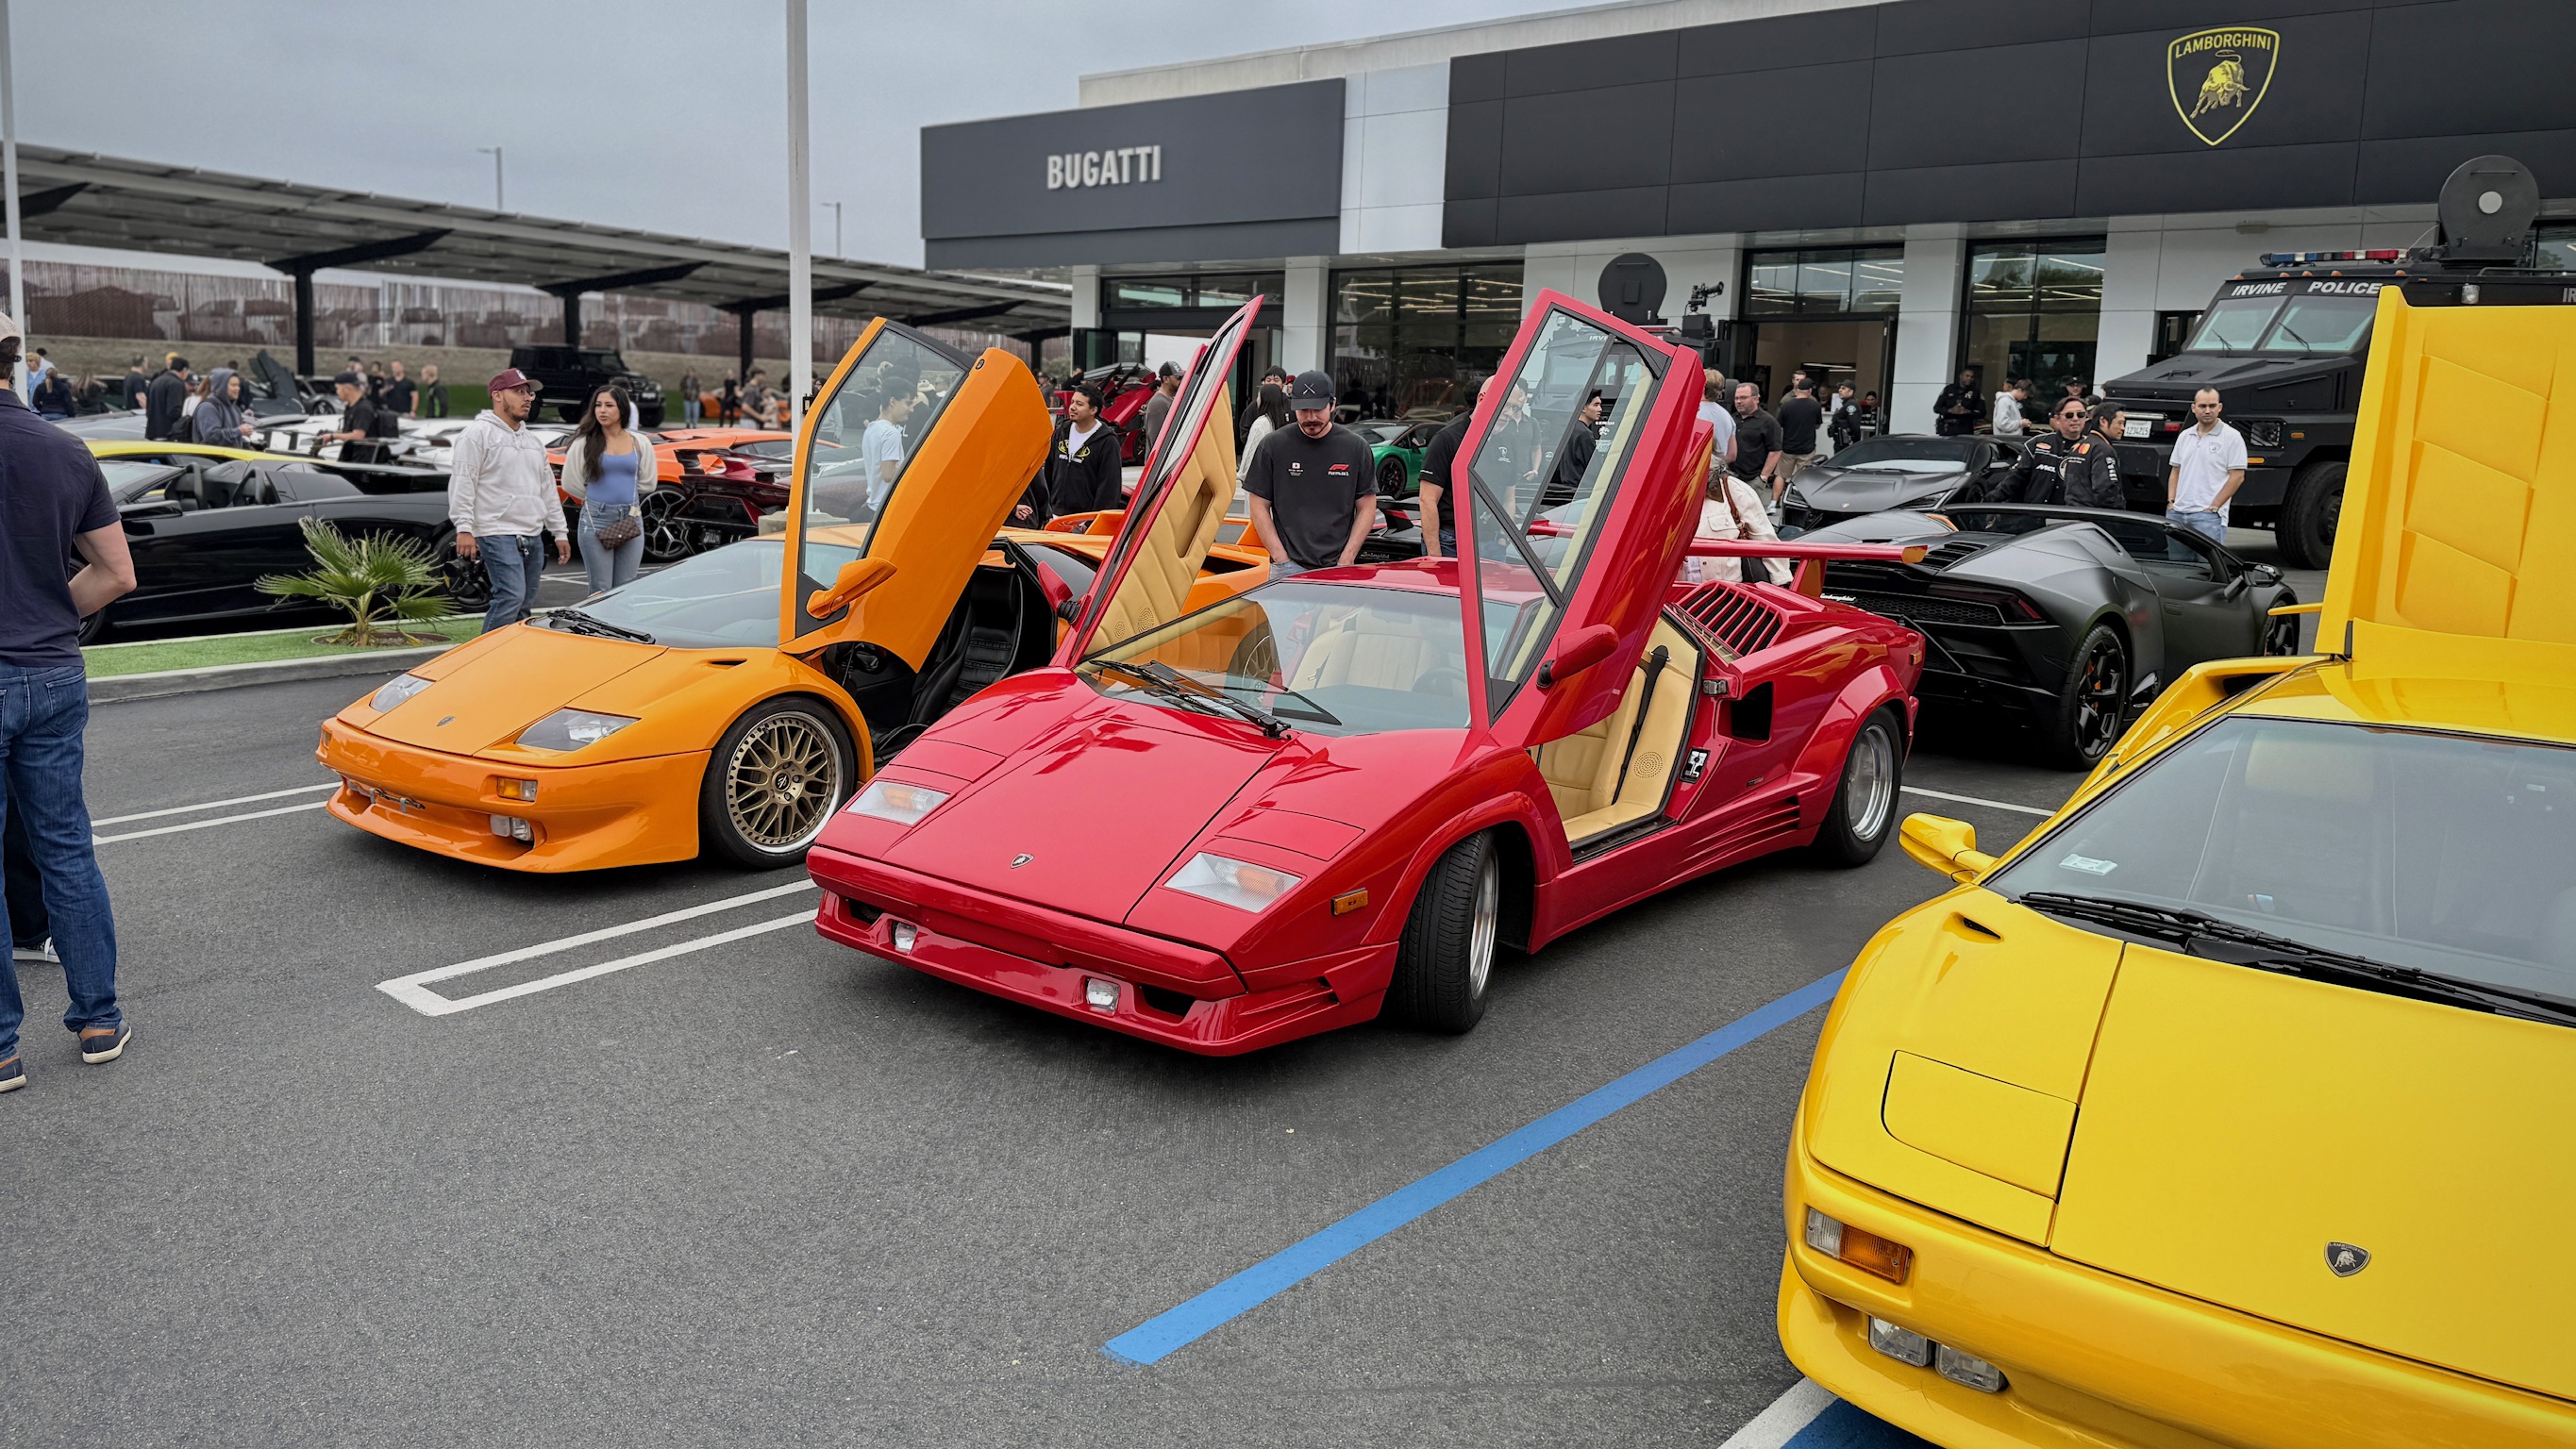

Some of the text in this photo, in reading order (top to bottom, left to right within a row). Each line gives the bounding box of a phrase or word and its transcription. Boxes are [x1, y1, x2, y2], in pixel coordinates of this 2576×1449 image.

[2175, 33, 2271, 58] LAMBORGHINI
[1047, 145, 1161, 190] BUGATTI
[2232, 281, 2383, 296] IRVINE POLICE
